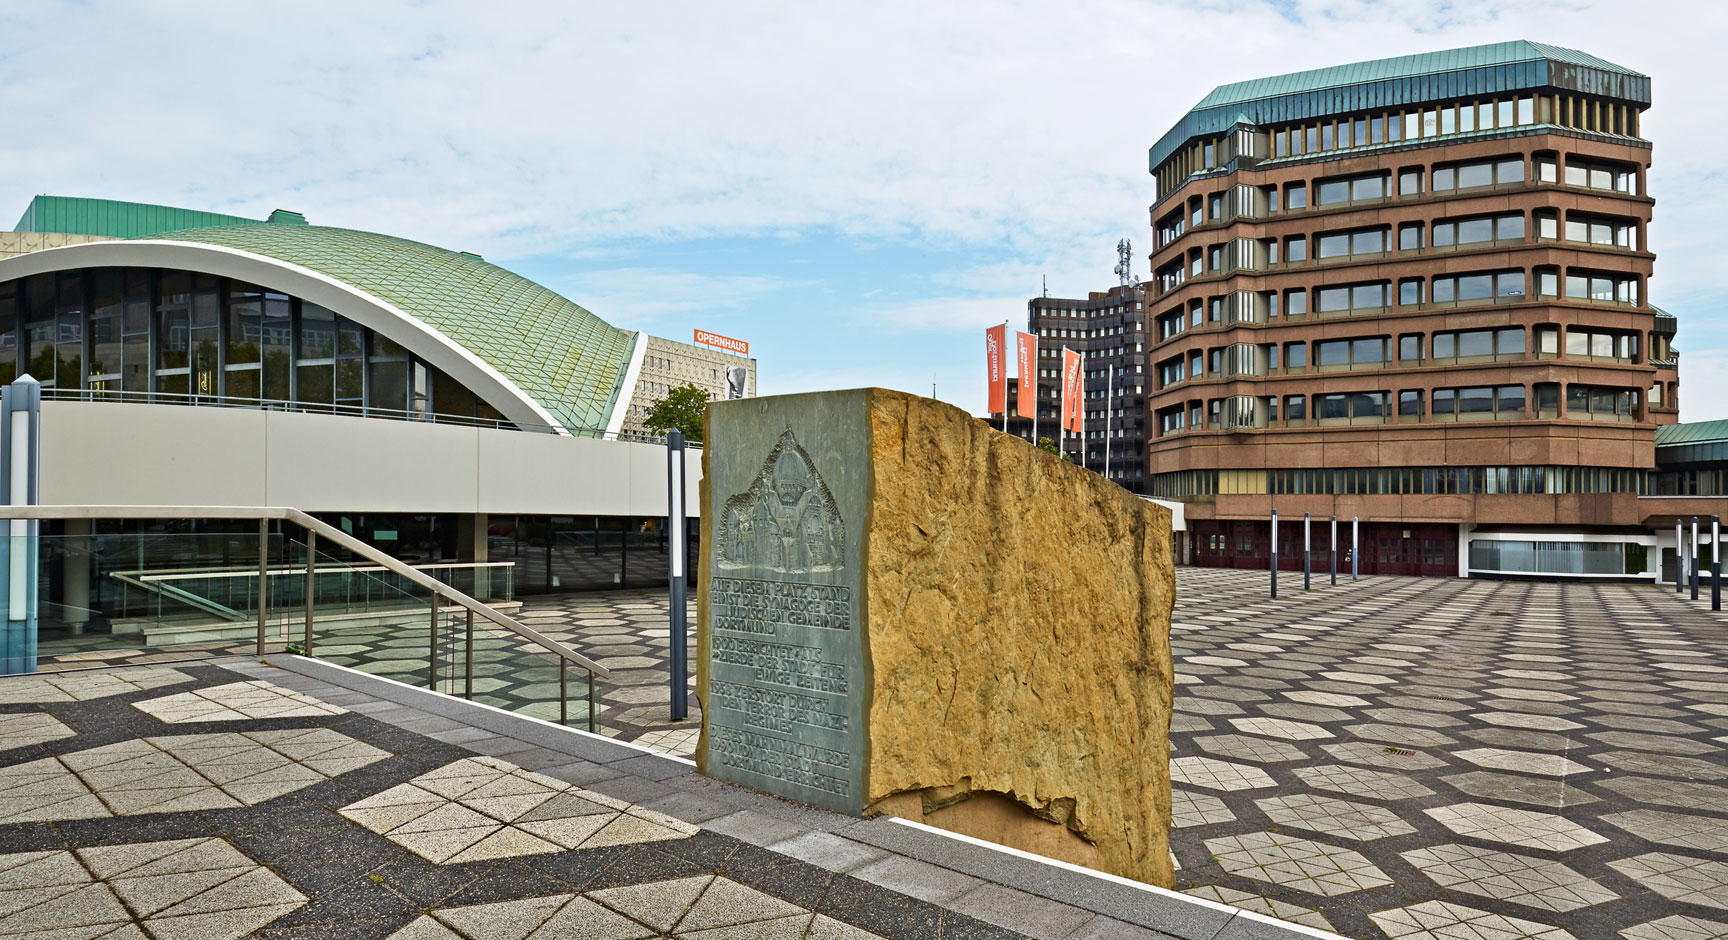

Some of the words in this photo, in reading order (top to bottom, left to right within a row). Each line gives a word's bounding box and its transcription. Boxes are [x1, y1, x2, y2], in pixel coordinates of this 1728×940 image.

[697, 332, 746, 352] OPERNHAUS
[711, 579, 730, 592] AUF
[734, 580, 770, 596] DIESEM
[774, 583, 807, 598] PLATZ
[812, 586, 850, 602] STAND
[712, 592, 740, 605] EINST
[743, 594, 759, 608] DIE
[762, 595, 820, 614] SYNAGOGE
[825, 600, 849, 616] DER
[716, 616, 776, 634] DORTMUND
[788, 610, 850, 630] GEMEINDE
[712, 636, 735, 650] 1900
[737, 639, 792, 659] ERRICHTET
[796, 648, 822, 664] ALS
[758, 654, 779, 670] DER
[782, 658, 816, 676] STADT
[756, 668, 790, 685] EWIGE
[722, 696, 741, 711] DEN
[745, 700, 786, 720] TERROR
[789, 707, 809, 724] DES
[789, 694, 829, 714] DURCH
[710, 725, 742, 744] DIESES
[722, 752, 783, 778] DORTMUND
[786, 769, 849, 794] ERRICHTET
[784, 754, 820, 773] STADT
